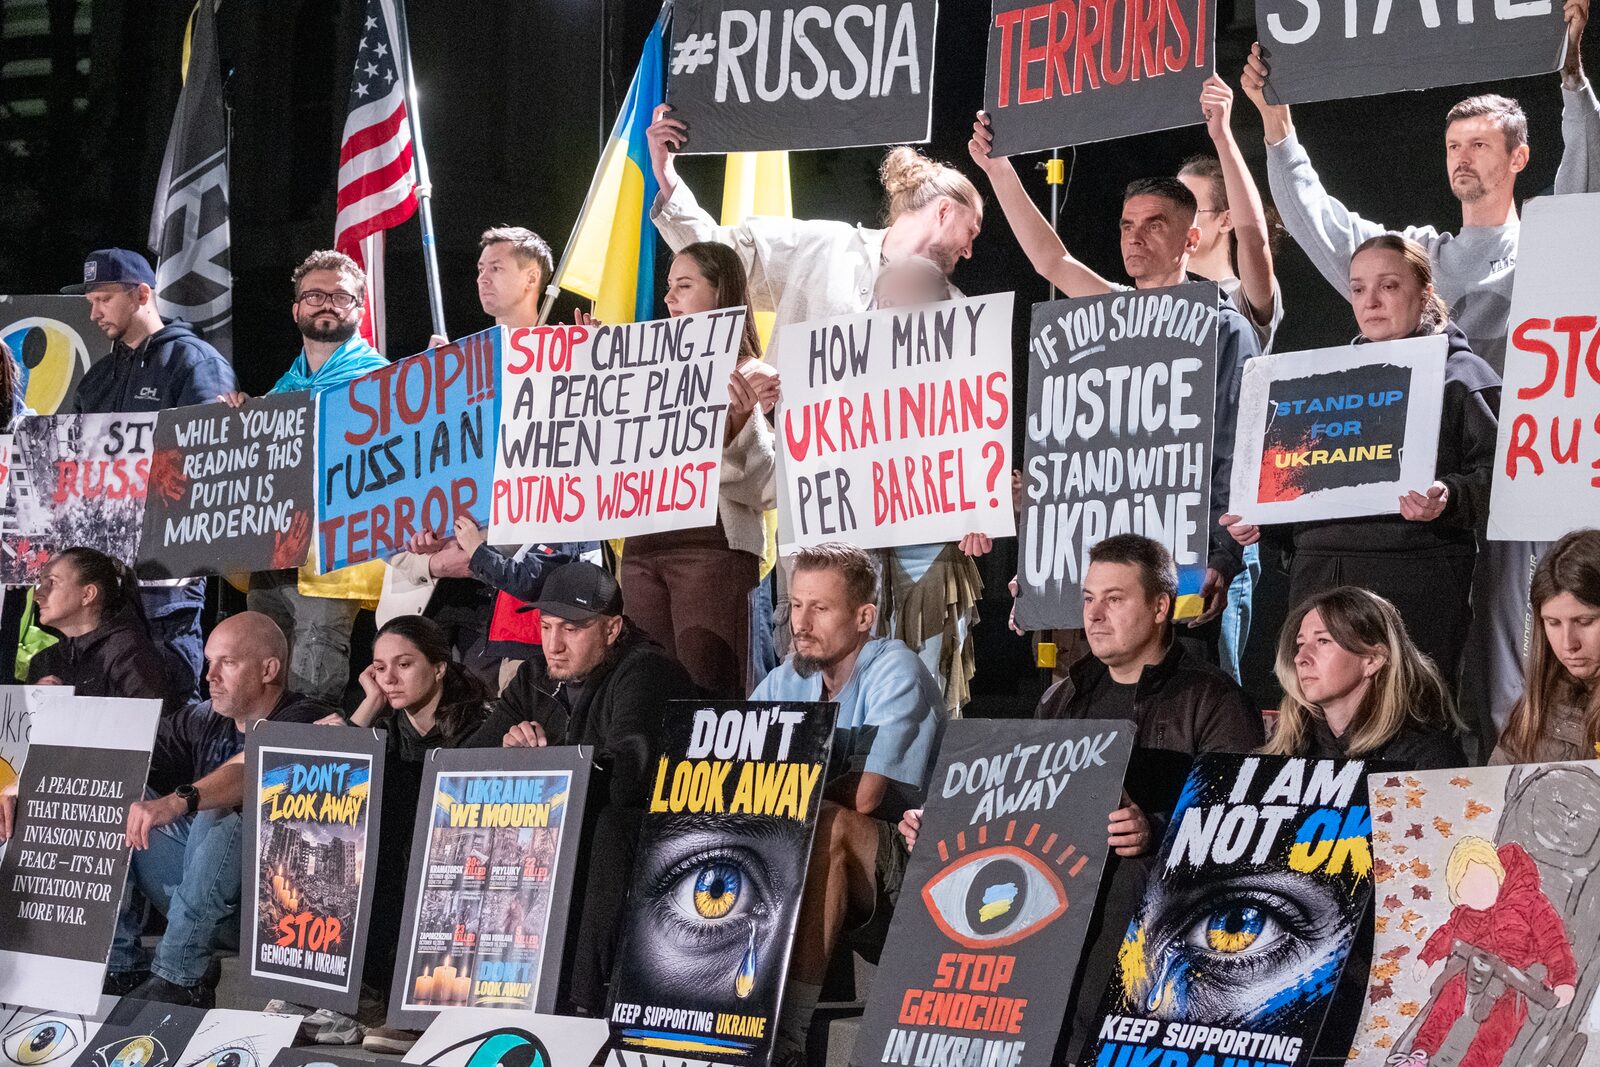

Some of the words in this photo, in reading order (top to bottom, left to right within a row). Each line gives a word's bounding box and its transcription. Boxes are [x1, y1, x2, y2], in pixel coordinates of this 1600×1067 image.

[672, 2, 920, 103] #RUSSIA
[995, 0, 1206, 108] TERRORIST
[507, 327, 589, 375] STOP
[591, 317, 695, 371] CALLING
[700, 310, 745, 358] IT
[808, 319, 872, 388] HOW
[892, 303, 986, 370] MANY
[1030, 325, 1059, 369] IF
[1058, 300, 1105, 351] YOU
[1109, 294, 1218, 346] SUPPORT
[344, 331, 495, 445] STOP!!!
[513, 377, 534, 420] A
[549, 373, 635, 419] PEACE
[643, 360, 714, 413] PLAN
[1028, 357, 1202, 441] JUSTICE
[1276, 395, 1364, 418] STAND
[1368, 390, 1403, 409] UP
[175, 416, 230, 448] WHILE
[501, 419, 601, 469] WHEN
[610, 415, 651, 465] IT
[650, 404, 727, 459] JUST
[784, 371, 1009, 462] UKRAINIANS
[1311, 420, 1361, 439] FOR
[183, 447, 259, 479] READING
[266, 438, 303, 470] THIS
[1275, 443, 1393, 469] UKRAINE
[1506, 413, 1600, 481] RU
[190, 476, 250, 510] PUTIN
[256, 473, 274, 503] IS
[1028, 447, 1124, 500] STAND
[1127, 442, 1204, 491] WITH
[164, 498, 294, 547] MURDERING
[797, 467, 857, 535] PER
[320, 477, 481, 571] TERROR
[686, 706, 806, 761] DON'T
[291, 762, 350, 796] DON'T
[942, 743, 1041, 799] DON'T
[1040, 730, 1118, 776] LOOK
[1227, 756, 1262, 805] I
[1260, 757, 1365, 808] AM
[36, 776, 47, 793] A
[48, 776, 89, 797] PEACE
[90, 778, 124, 800] DEAL
[269, 791, 318, 822] LOOK
[319, 793, 363, 829] AWAY
[465, 779, 545, 804] UKRAINE
[650, 754, 732, 815] LOOK
[729, 760, 822, 823] AWAY
[969, 773, 1071, 826] AWAY
[27, 801, 60, 821] THAT
[60, 803, 124, 825] REWARDS
[450, 803, 481, 828] WE
[480, 803, 551, 828] MOURN
[23, 825, 81, 848] INVASION
[82, 829, 96, 849] IS
[95, 831, 126, 851] NOT
[1164, 804, 1298, 871] NOT
[1287, 805, 1372, 879] OK
[17, 850, 57, 870] PEACE
[94, 857, 115, 877] AN
[523, 867, 548, 877] KILLED
[11, 874, 86, 900] INVITATION
[85, 881, 112, 903] FOR
[17, 901, 54, 923] MORE
[54, 905, 87, 926] WAR.
[277, 911, 342, 953] STOP
[260, 943, 303, 969] GENOCIDE
[304, 951, 314, 971] IN
[314, 952, 347, 977] UKRAINE
[933, 952, 1017, 993] STOP
[474, 980, 503, 996] LOOK
[502, 983, 532, 998] AWAY
[898, 988, 1028, 1034] GENOCIDE
[612, 1002, 642, 1025] KEEP
[643, 1005, 714, 1033] SUPPORTING
[716, 1013, 767, 1039] UKRAINE
[1098, 1014, 1160, 1044] KEEP
[1162, 1022, 1303, 1063] SUPPORTING
[881, 1028, 917, 1065] IN
[914, 1032, 1026, 1067] UKRAINE
